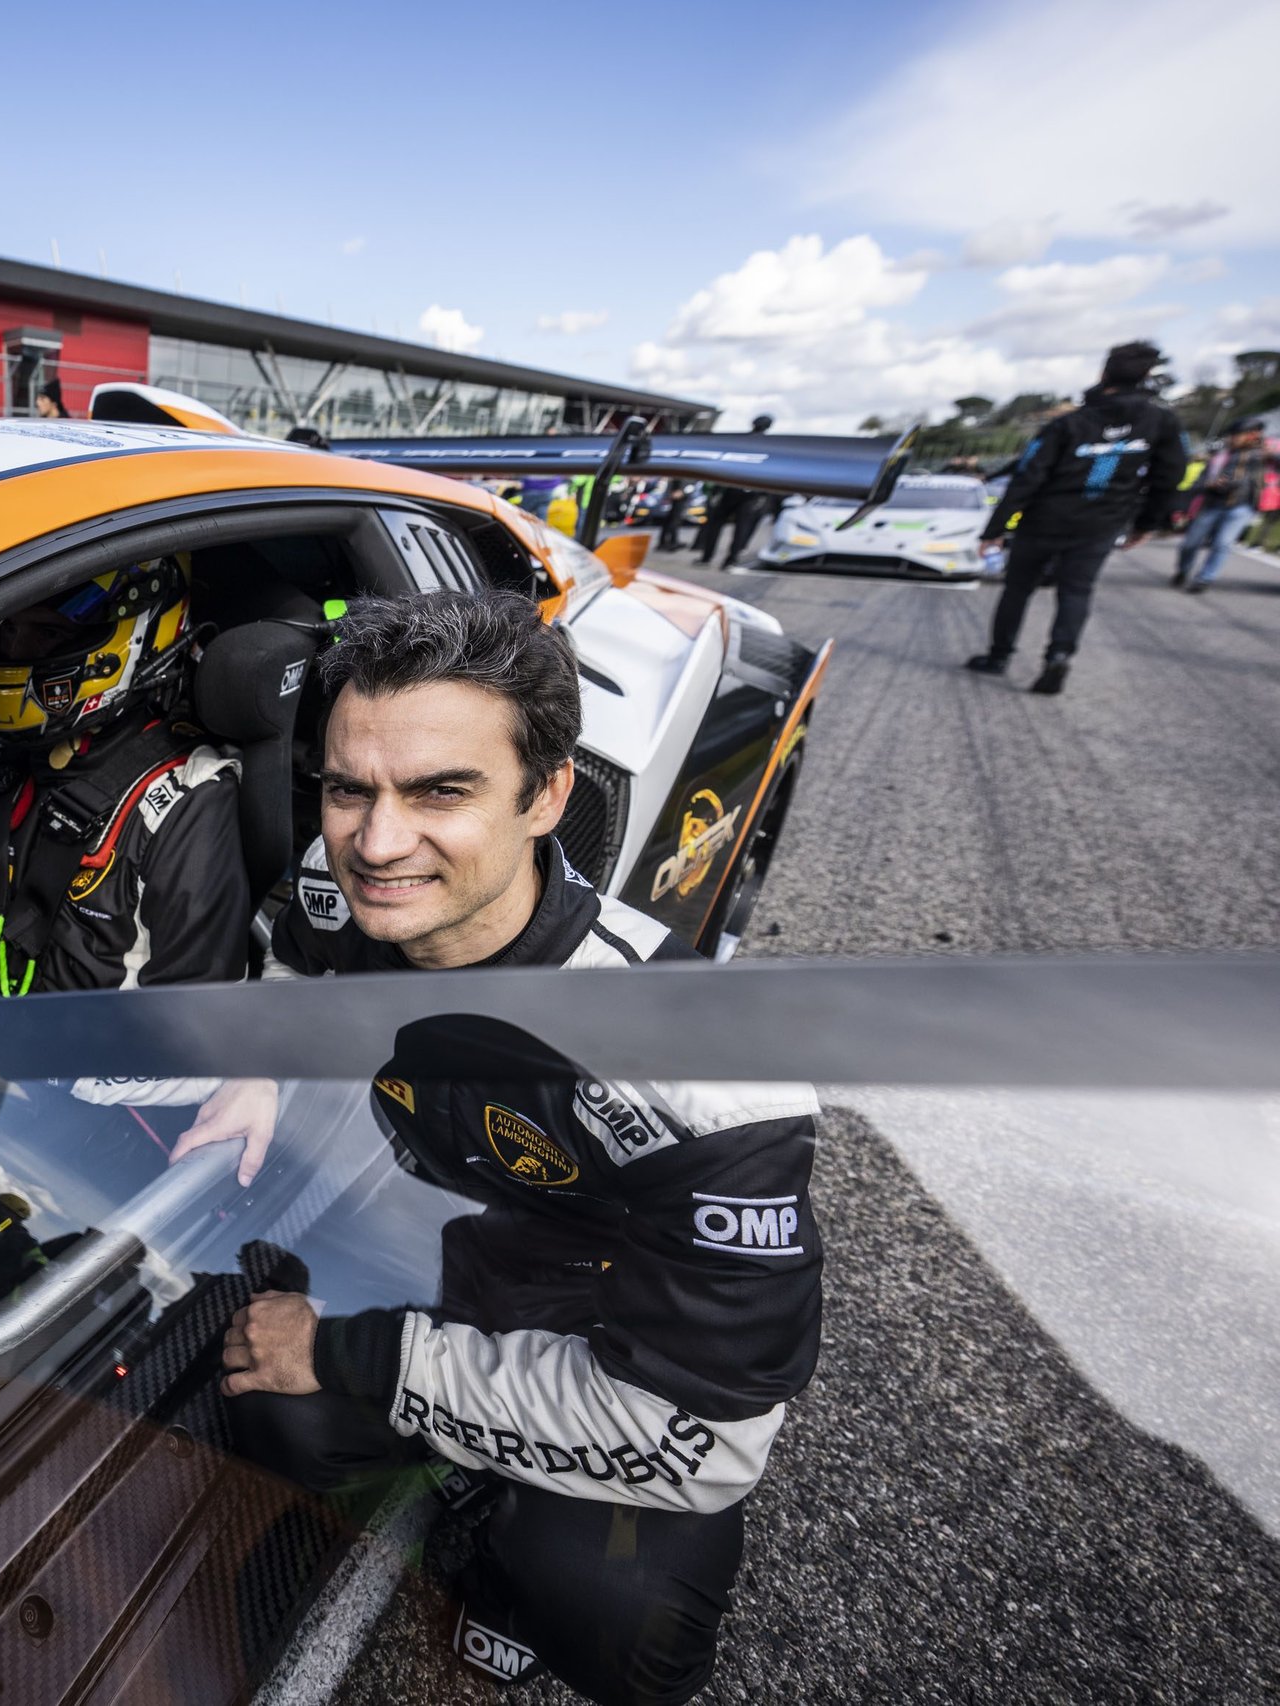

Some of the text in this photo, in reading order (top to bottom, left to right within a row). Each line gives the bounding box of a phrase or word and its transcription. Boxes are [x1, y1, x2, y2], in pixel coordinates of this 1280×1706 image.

[304, 891, 337, 915] OMP
[582, 1079, 649, 1146] OMP
[491, 1123, 571, 1174] LAMBORGHINI
[496, 1114, 566, 1163] AUTOMOBILI
[693, 1204, 798, 1247] OMP
